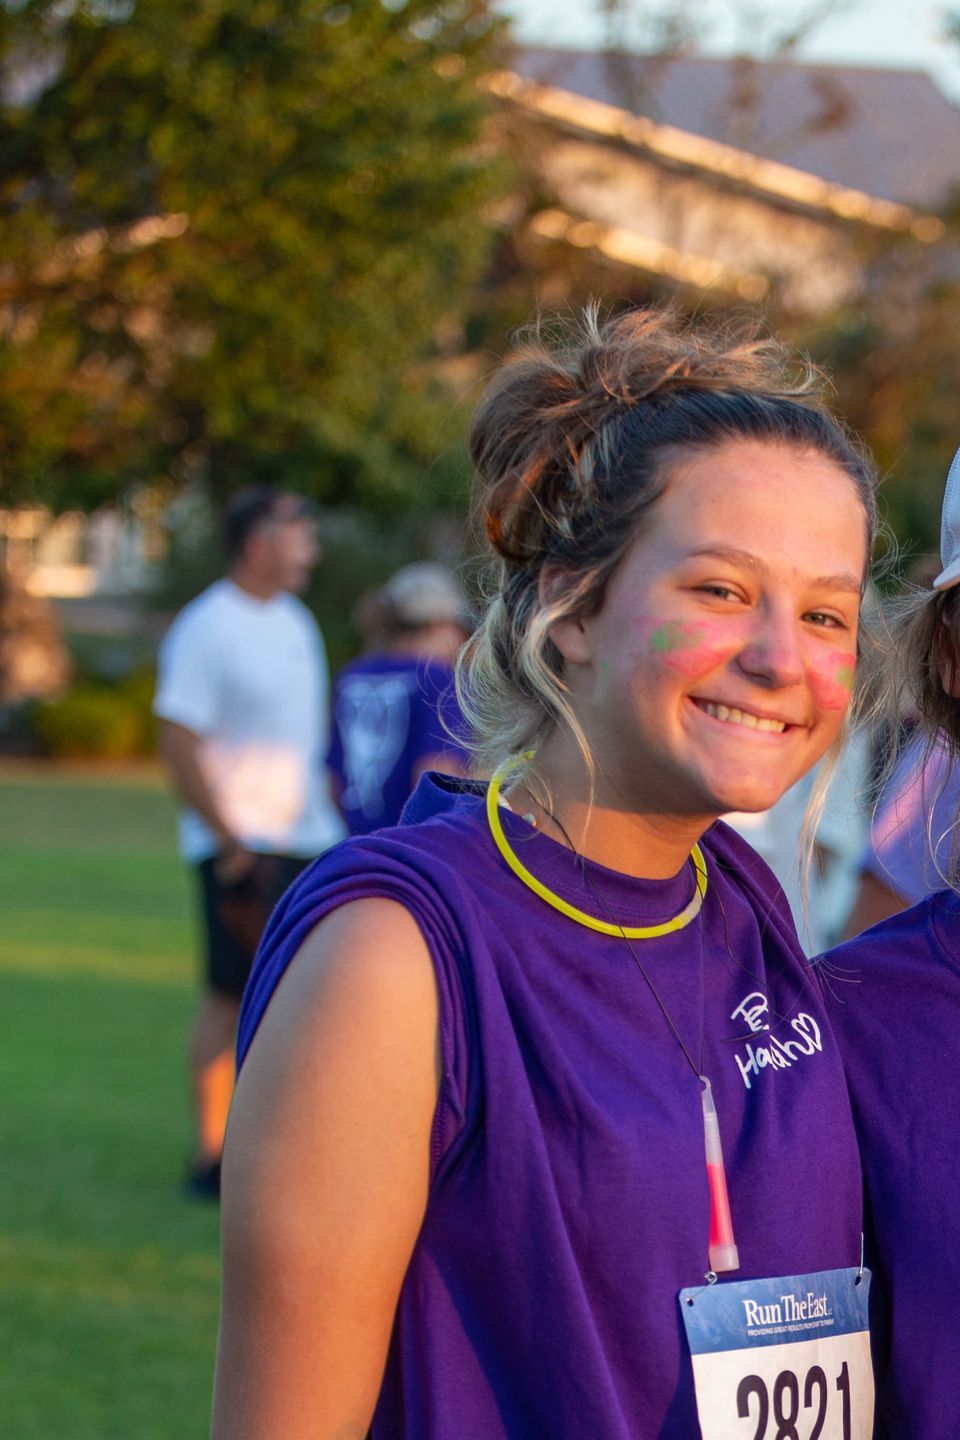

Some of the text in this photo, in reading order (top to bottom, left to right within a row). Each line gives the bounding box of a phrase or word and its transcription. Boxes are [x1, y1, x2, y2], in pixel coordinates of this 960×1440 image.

[742, 1291, 829, 1327] Run The East
